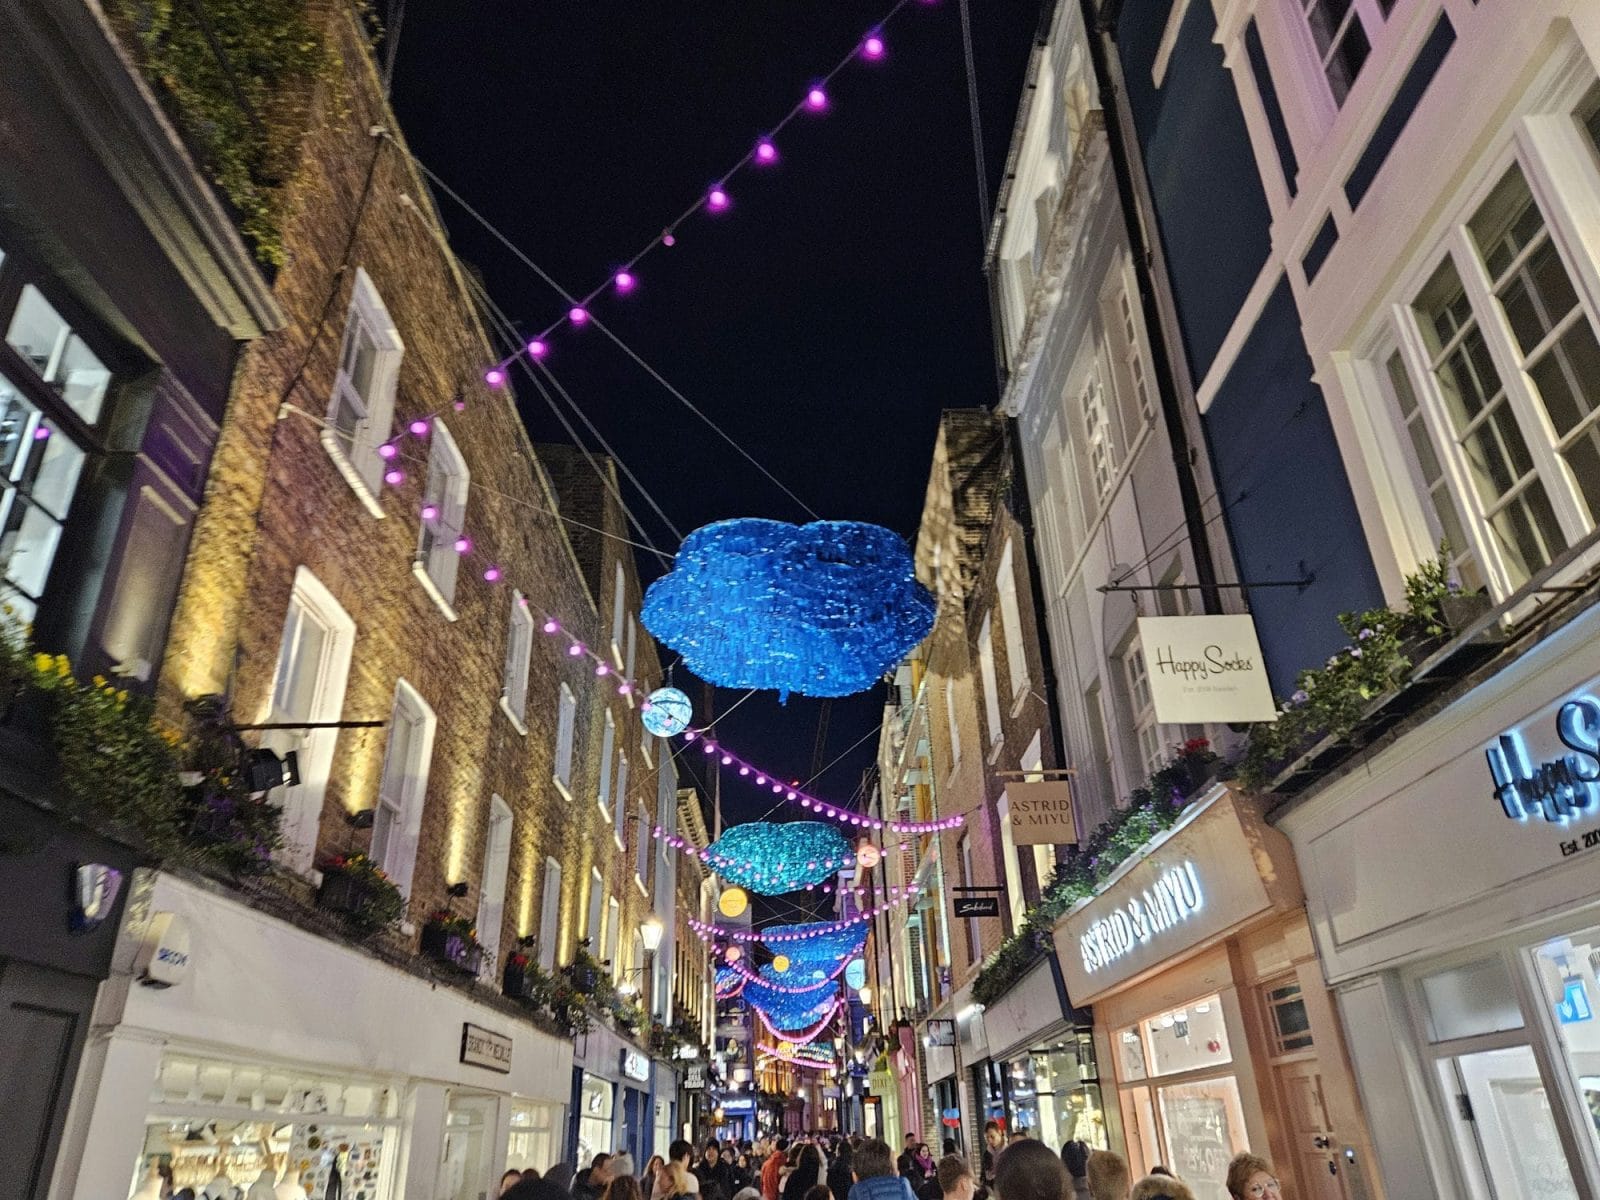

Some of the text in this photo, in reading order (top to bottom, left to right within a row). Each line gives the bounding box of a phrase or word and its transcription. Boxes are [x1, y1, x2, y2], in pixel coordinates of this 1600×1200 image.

[1156, 645, 1253, 680] Happy Socks
[1011, 800, 1070, 813] ASTRID
[1012, 813, 1071, 826] & MIYU
[1080, 862, 1202, 973] ASTRID & MIYU
